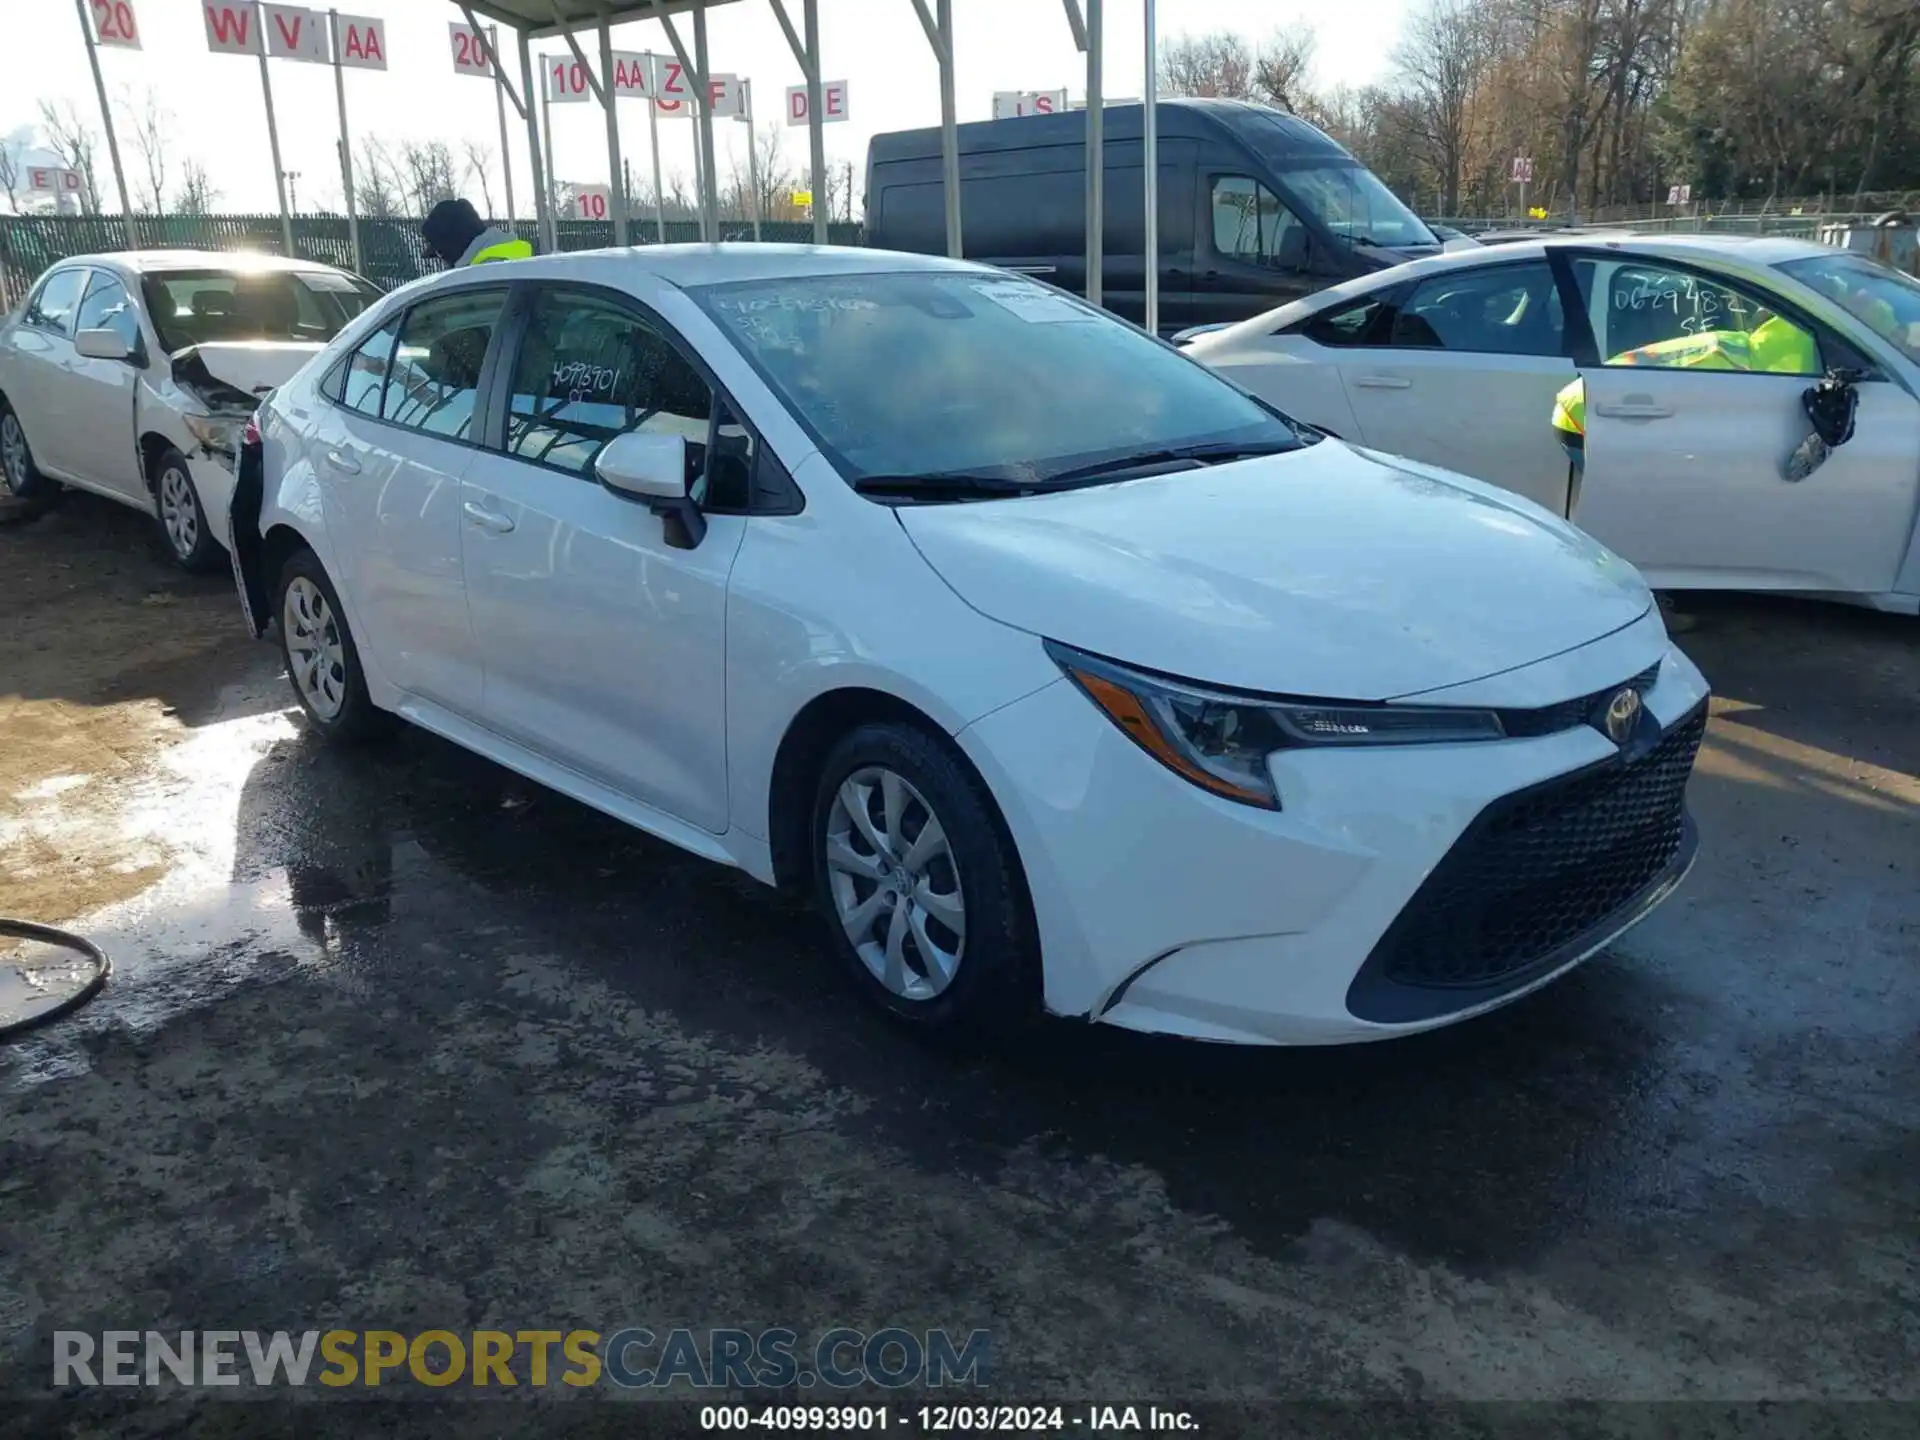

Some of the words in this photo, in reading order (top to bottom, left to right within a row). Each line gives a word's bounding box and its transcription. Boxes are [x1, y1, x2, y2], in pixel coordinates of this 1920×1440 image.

[93, 0, 134, 39] 20
[207, 6, 248, 46] W
[274, 13, 302, 50] V
[345, 23, 382, 60] AA
[454, 32, 488, 68] 20
[553, 62, 588, 94] 10
[615, 59, 645, 91] AA
[664, 63, 684, 92] Z
[791, 92, 808, 118] D
[827, 88, 842, 114] E
[33, 171, 51, 188] E
[64, 172, 80, 189] D
[578, 194, 605, 218] 10
